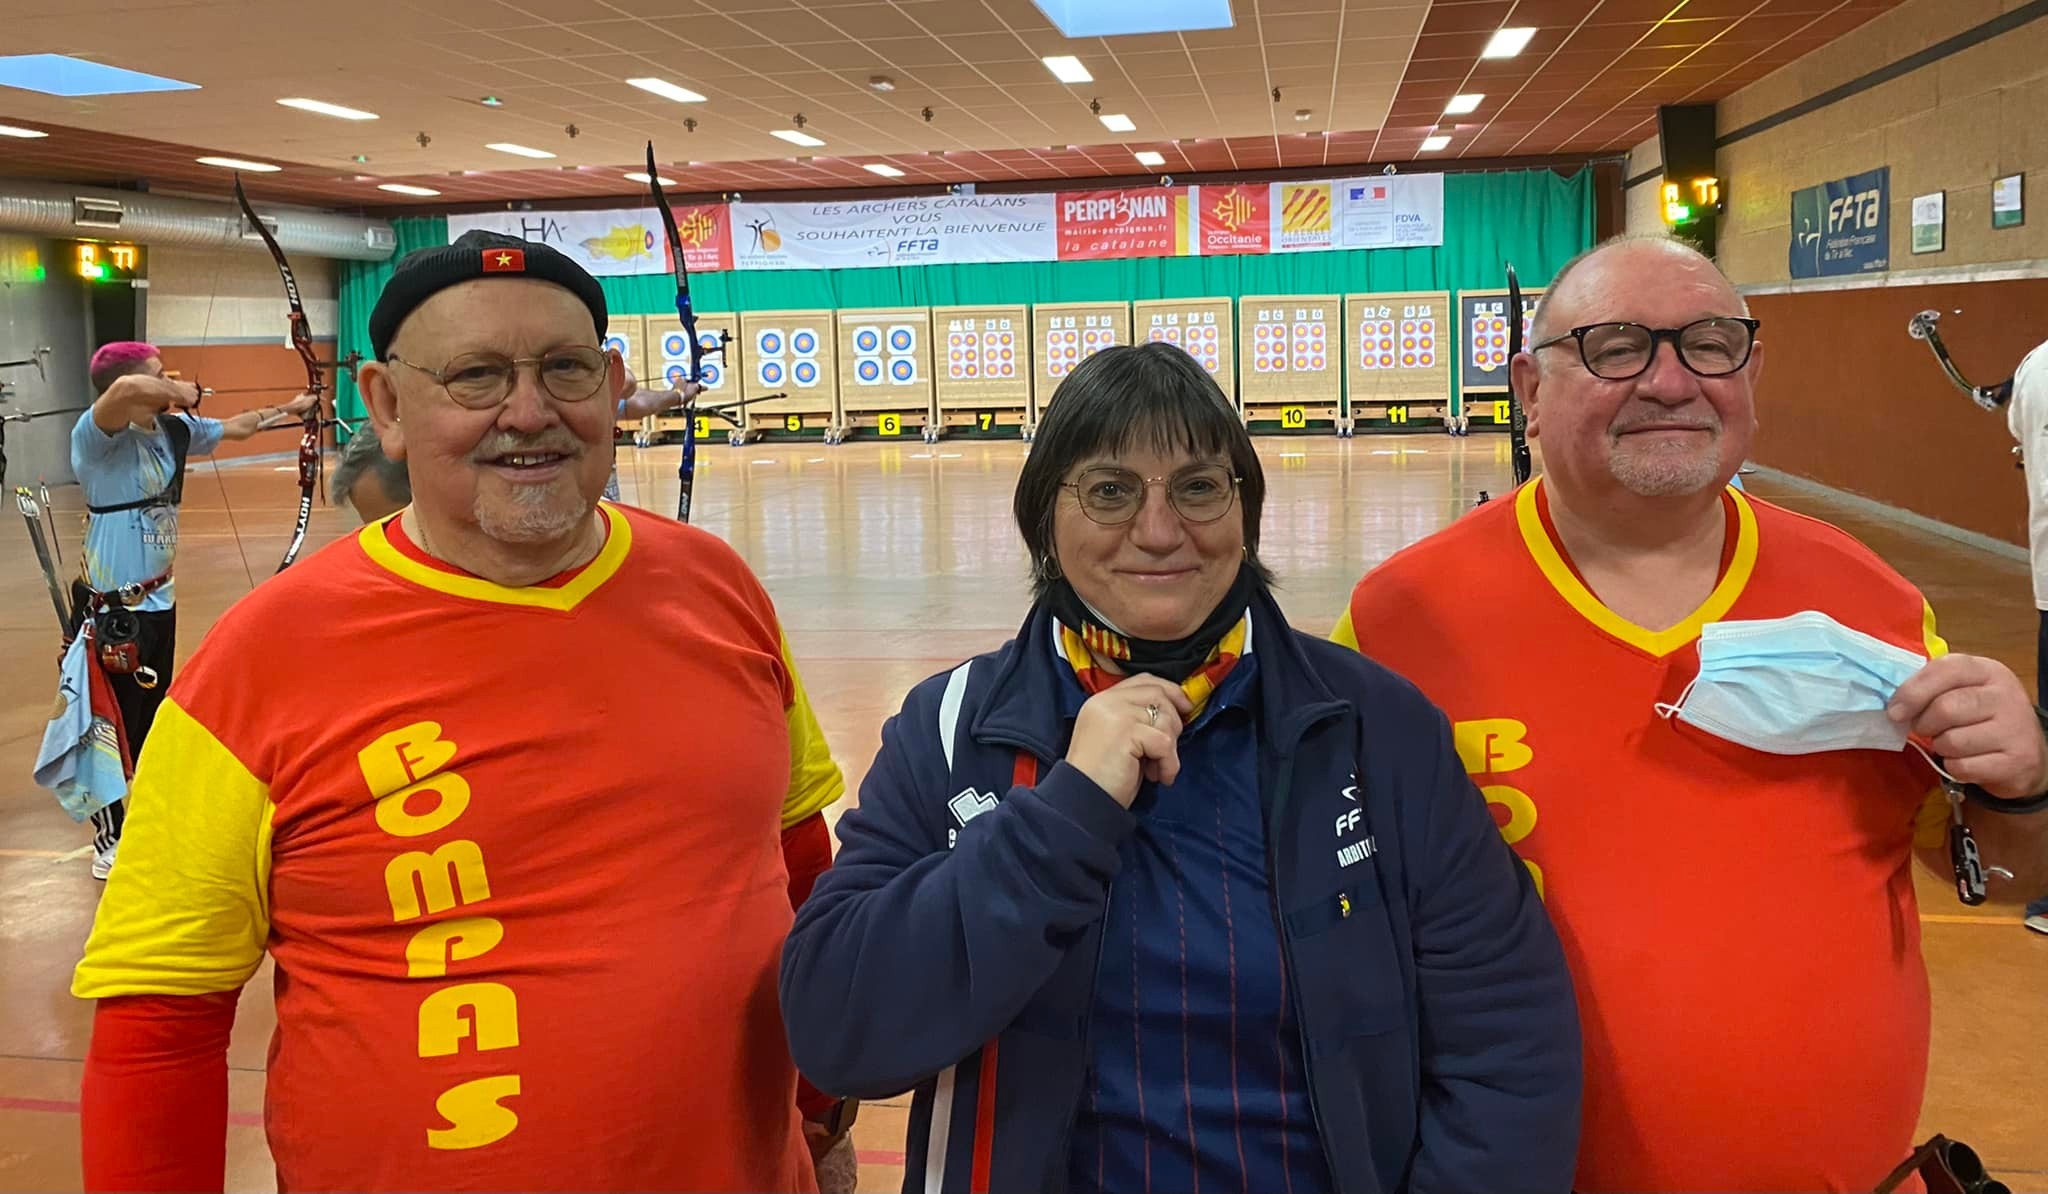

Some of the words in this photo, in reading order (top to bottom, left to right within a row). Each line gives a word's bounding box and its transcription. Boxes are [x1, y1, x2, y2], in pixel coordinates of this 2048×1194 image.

[812, 206, 841, 216] LES
[846, 200, 927, 215] ARCHERS
[934, 198, 1027, 209] CATALANS
[893, 212, 942, 224] VOUS
[1396, 214, 1421, 223] FDVA
[796, 227, 911, 241] SOUHAITENT
[916, 226, 938, 236] LA
[944, 222, 1048, 234] BIENVENUE
[1065, 242, 1080, 252] la
[1090, 239, 1168, 251] catalane
[1207, 234, 1263, 246] Occitanie
[980, 414, 992, 430] 7
[1285, 409, 1302, 424] 10
[1388, 406, 1407, 423] 11
[787, 416, 800, 431] 5
[884, 418, 896, 431] 6
[358, 720, 521, 1150] BOMPAS
